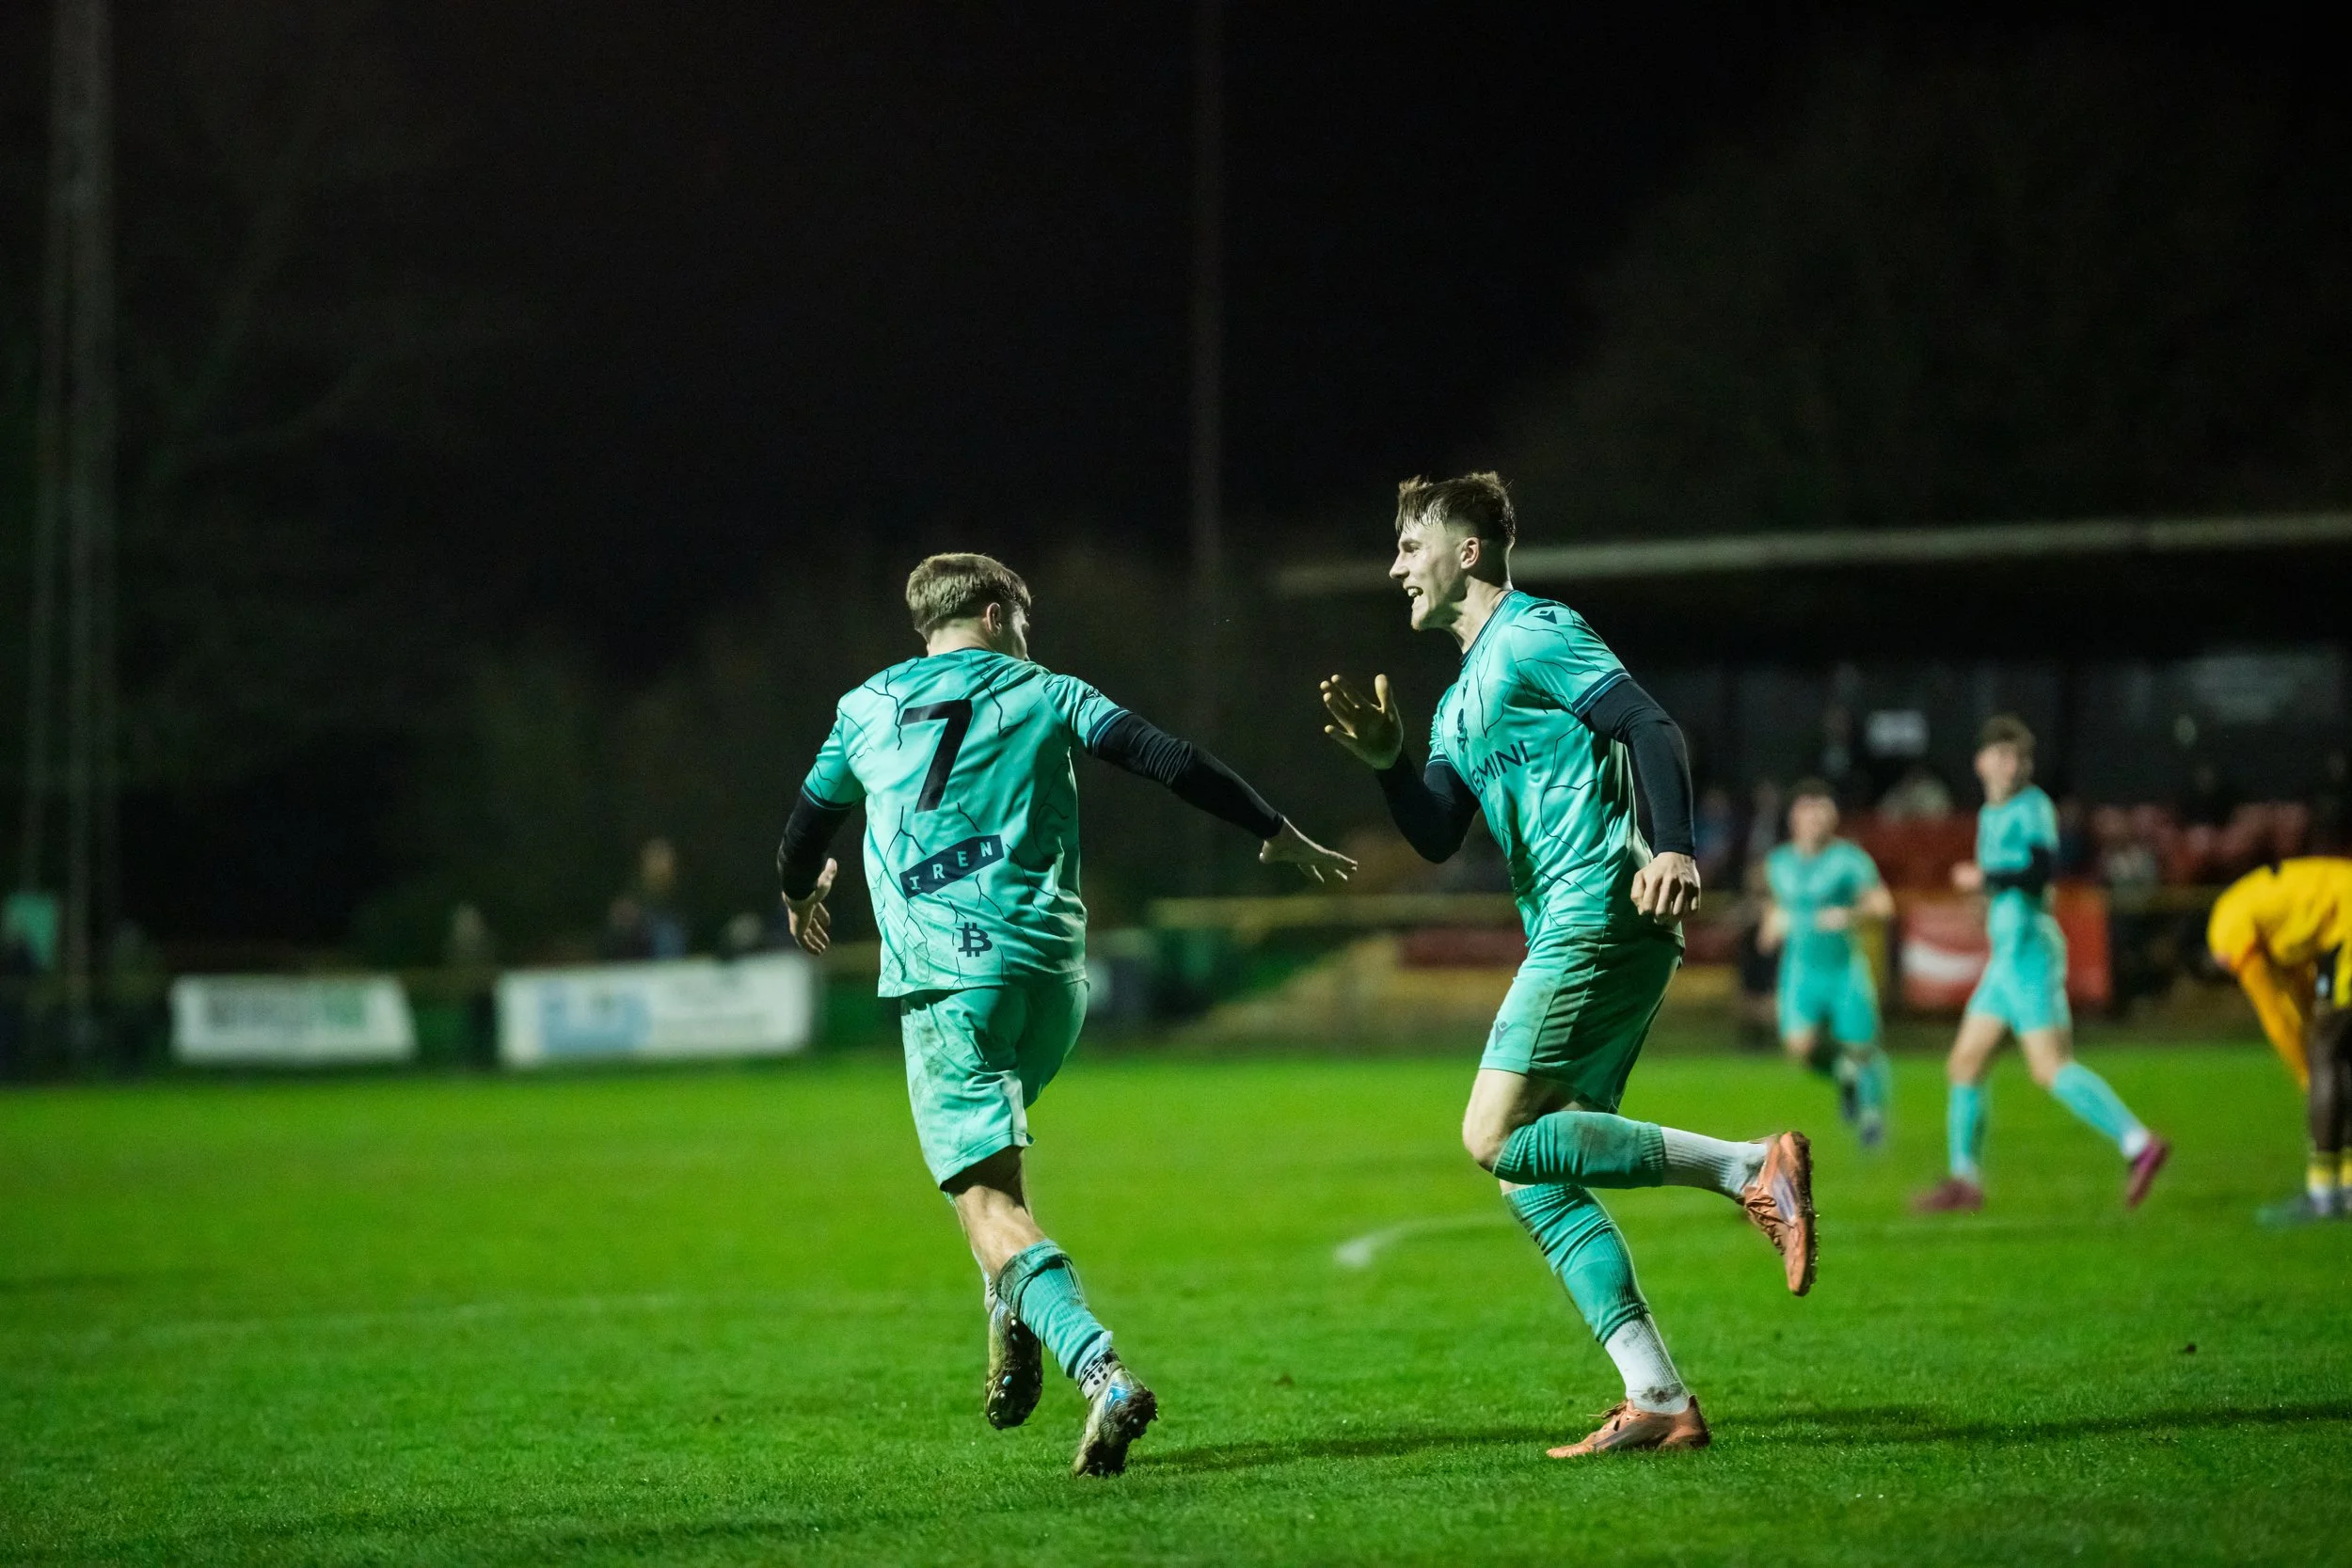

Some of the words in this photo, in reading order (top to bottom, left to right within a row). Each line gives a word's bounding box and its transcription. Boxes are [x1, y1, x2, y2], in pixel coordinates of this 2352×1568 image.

[900, 699, 973, 813] 7
[1472, 740, 1530, 795] EMINI
[909, 841, 993, 891] IREN
